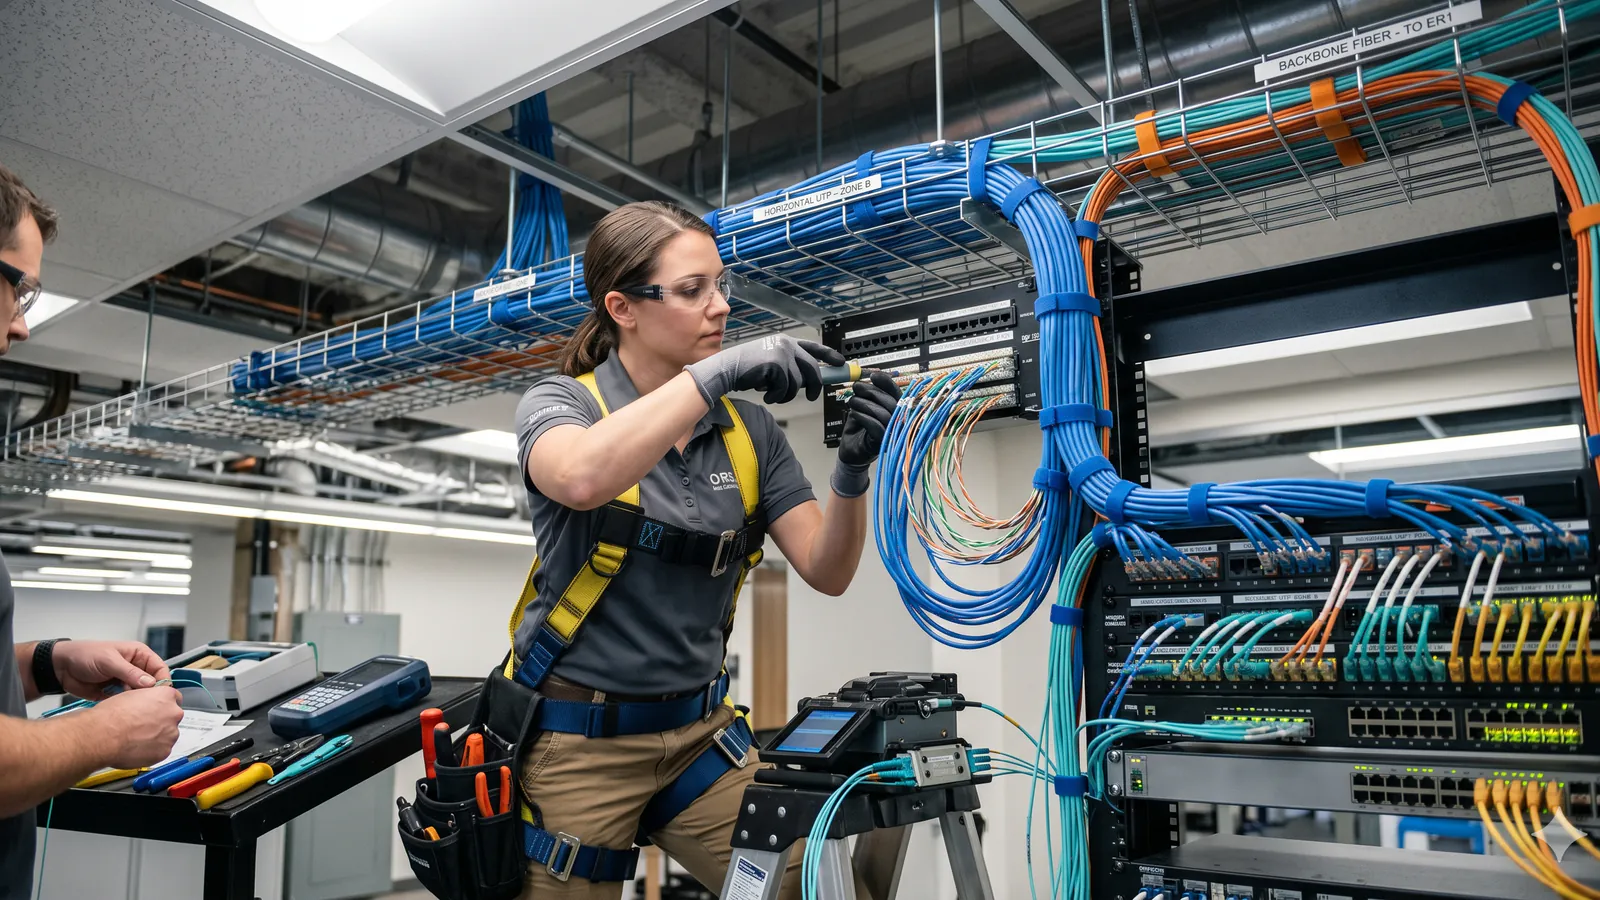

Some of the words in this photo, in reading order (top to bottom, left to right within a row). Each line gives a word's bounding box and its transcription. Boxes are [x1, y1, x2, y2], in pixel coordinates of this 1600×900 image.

[1279, 42, 1348, 71] BACKBONE
[1353, 30, 1392, 50] FIBER
[1403, 21, 1423, 35] TO
[1427, 12, 1453, 28] ER1
[764, 198, 814, 217] HORIZONTAL
[815, 191, 832, 202] UTP
[840, 181, 863, 195] ZONE
[865, 180, 871, 188] B
